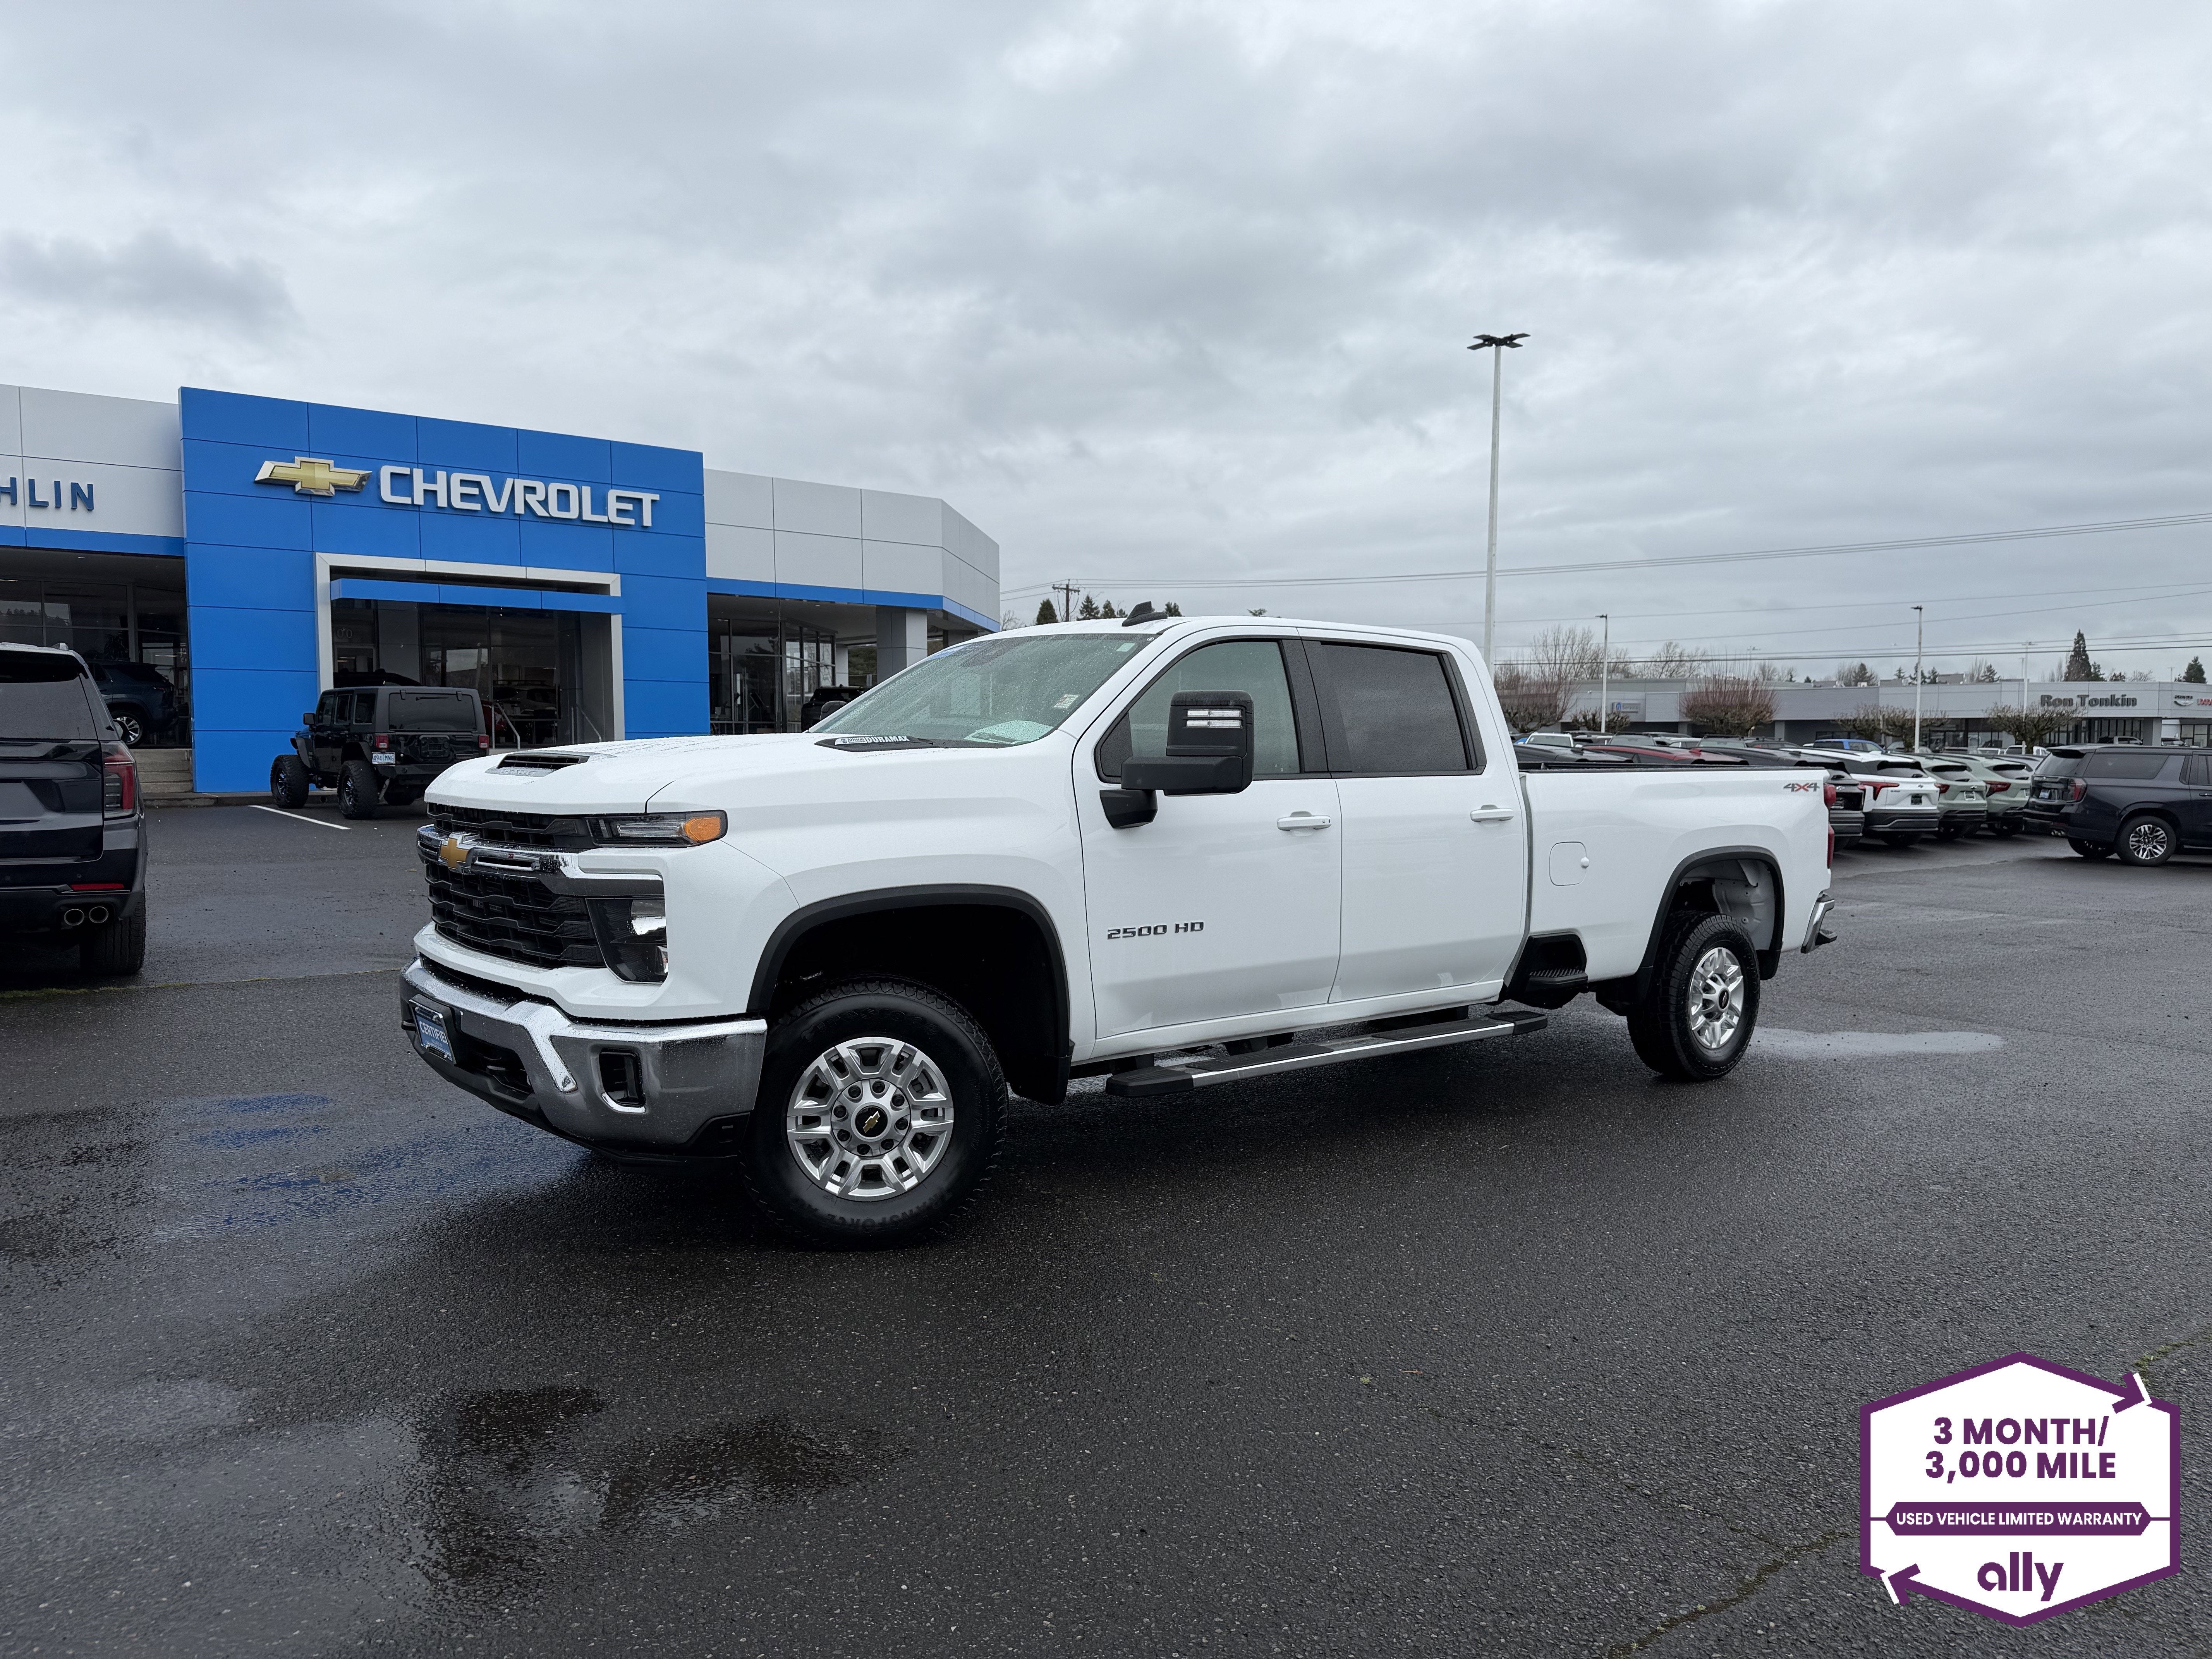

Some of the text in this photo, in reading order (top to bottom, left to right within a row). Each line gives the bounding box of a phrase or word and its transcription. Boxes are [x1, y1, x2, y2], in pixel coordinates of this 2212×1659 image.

[0, 477, 94, 511] HLIN
[380, 465, 660, 527] CHEVROLET
[2041, 694, 2137, 707] Ron Tonkin
[1108, 922, 1204, 939] 2500 HD
